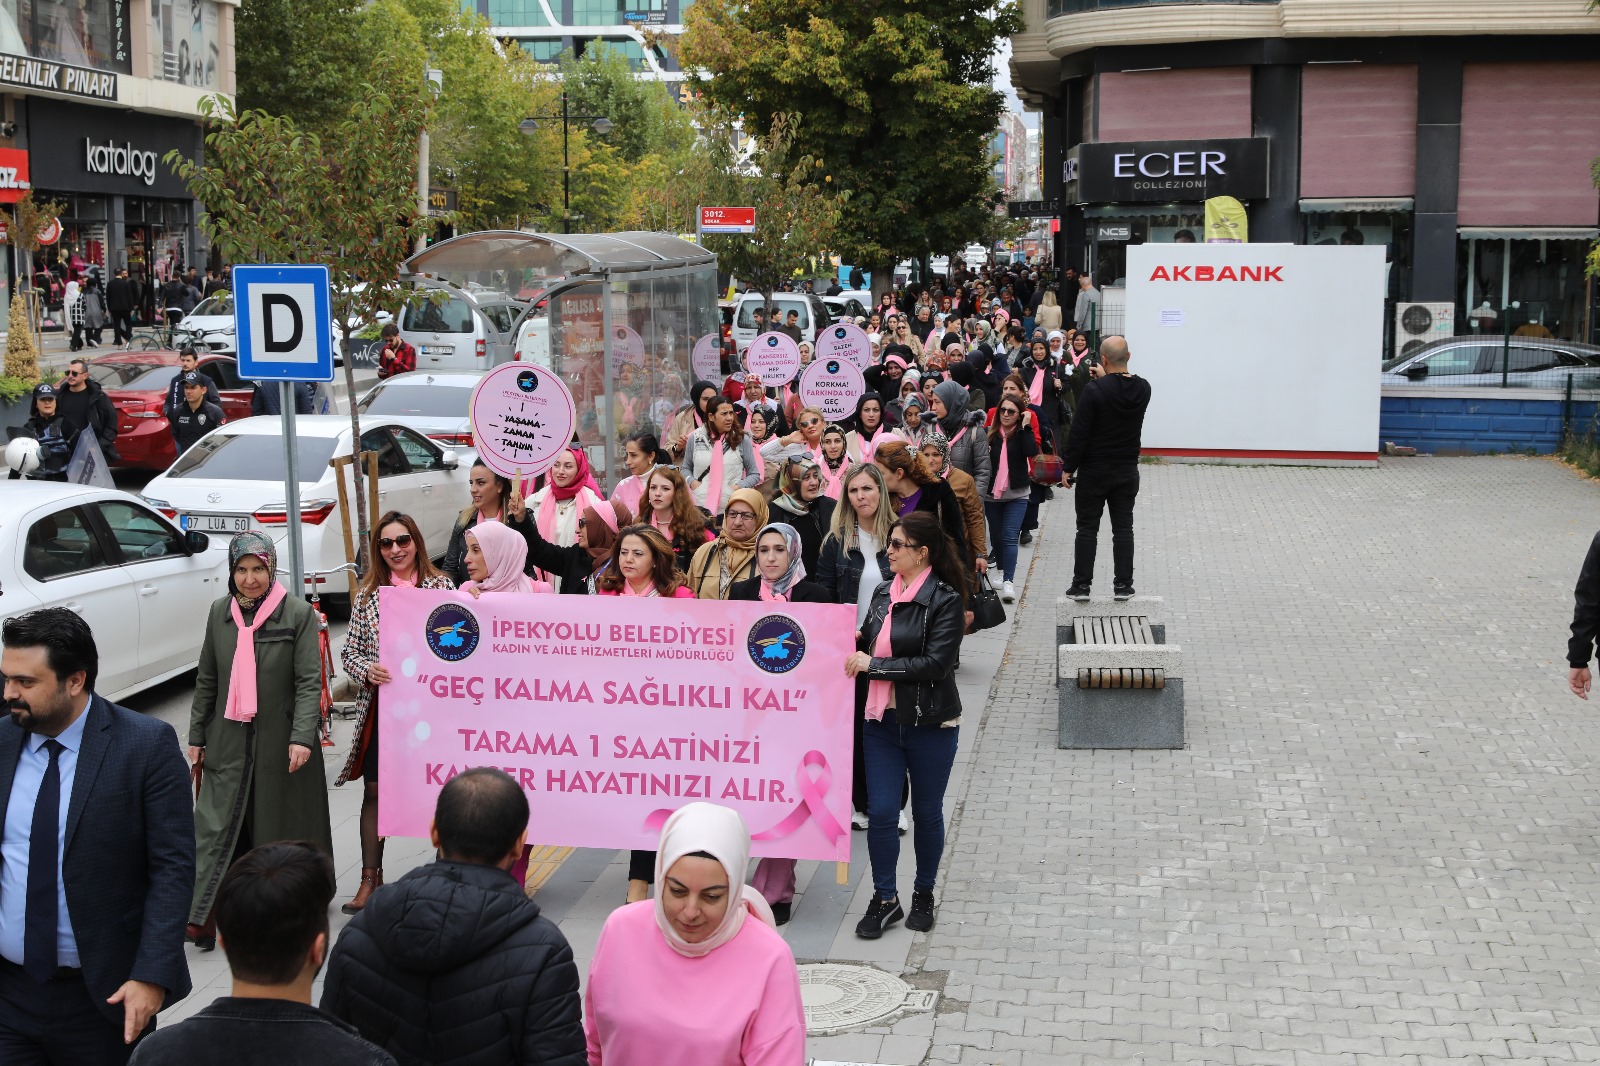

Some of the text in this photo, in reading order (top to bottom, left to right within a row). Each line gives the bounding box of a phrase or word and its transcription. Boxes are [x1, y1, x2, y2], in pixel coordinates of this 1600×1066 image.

[65, 67, 115, 98] PINARI
[86, 137, 156, 185] katalog
[1114, 151, 1226, 178] ECER
[1134, 180, 1207, 190] COLLEZIONI
[704, 210, 726, 218] 3012.
[1020, 201, 1059, 212] ECER
[1149, 265, 1285, 282] AKBANK
[262, 293, 304, 353] D
[806, 389, 857, 397] FARKINDA OL!
[824, 398, 839, 406] GEÇ
[504, 414, 541, 429] YAŞAMA
[503, 426, 535, 440] ZAMAN
[187, 517, 199, 529] 07
[208, 517, 227, 530] LUA
[234, 519, 247, 531] 60
[492, 615, 601, 642] İPEKYOLU
[609, 621, 735, 646] BELEDİYESİ
[492, 642, 735, 662] KADIN VE AİLE HİZMETLERİ MÜDÜRLÜĞÜ
[494, 677, 595, 703] KALMA
[603, 675, 731, 709] SAĞLIKLI
[457, 728, 760, 765] TARAMA 1 SAATİNİZİ
[546, 768, 711, 799] HAYATINIZI
[720, 776, 795, 804] ALIR.
